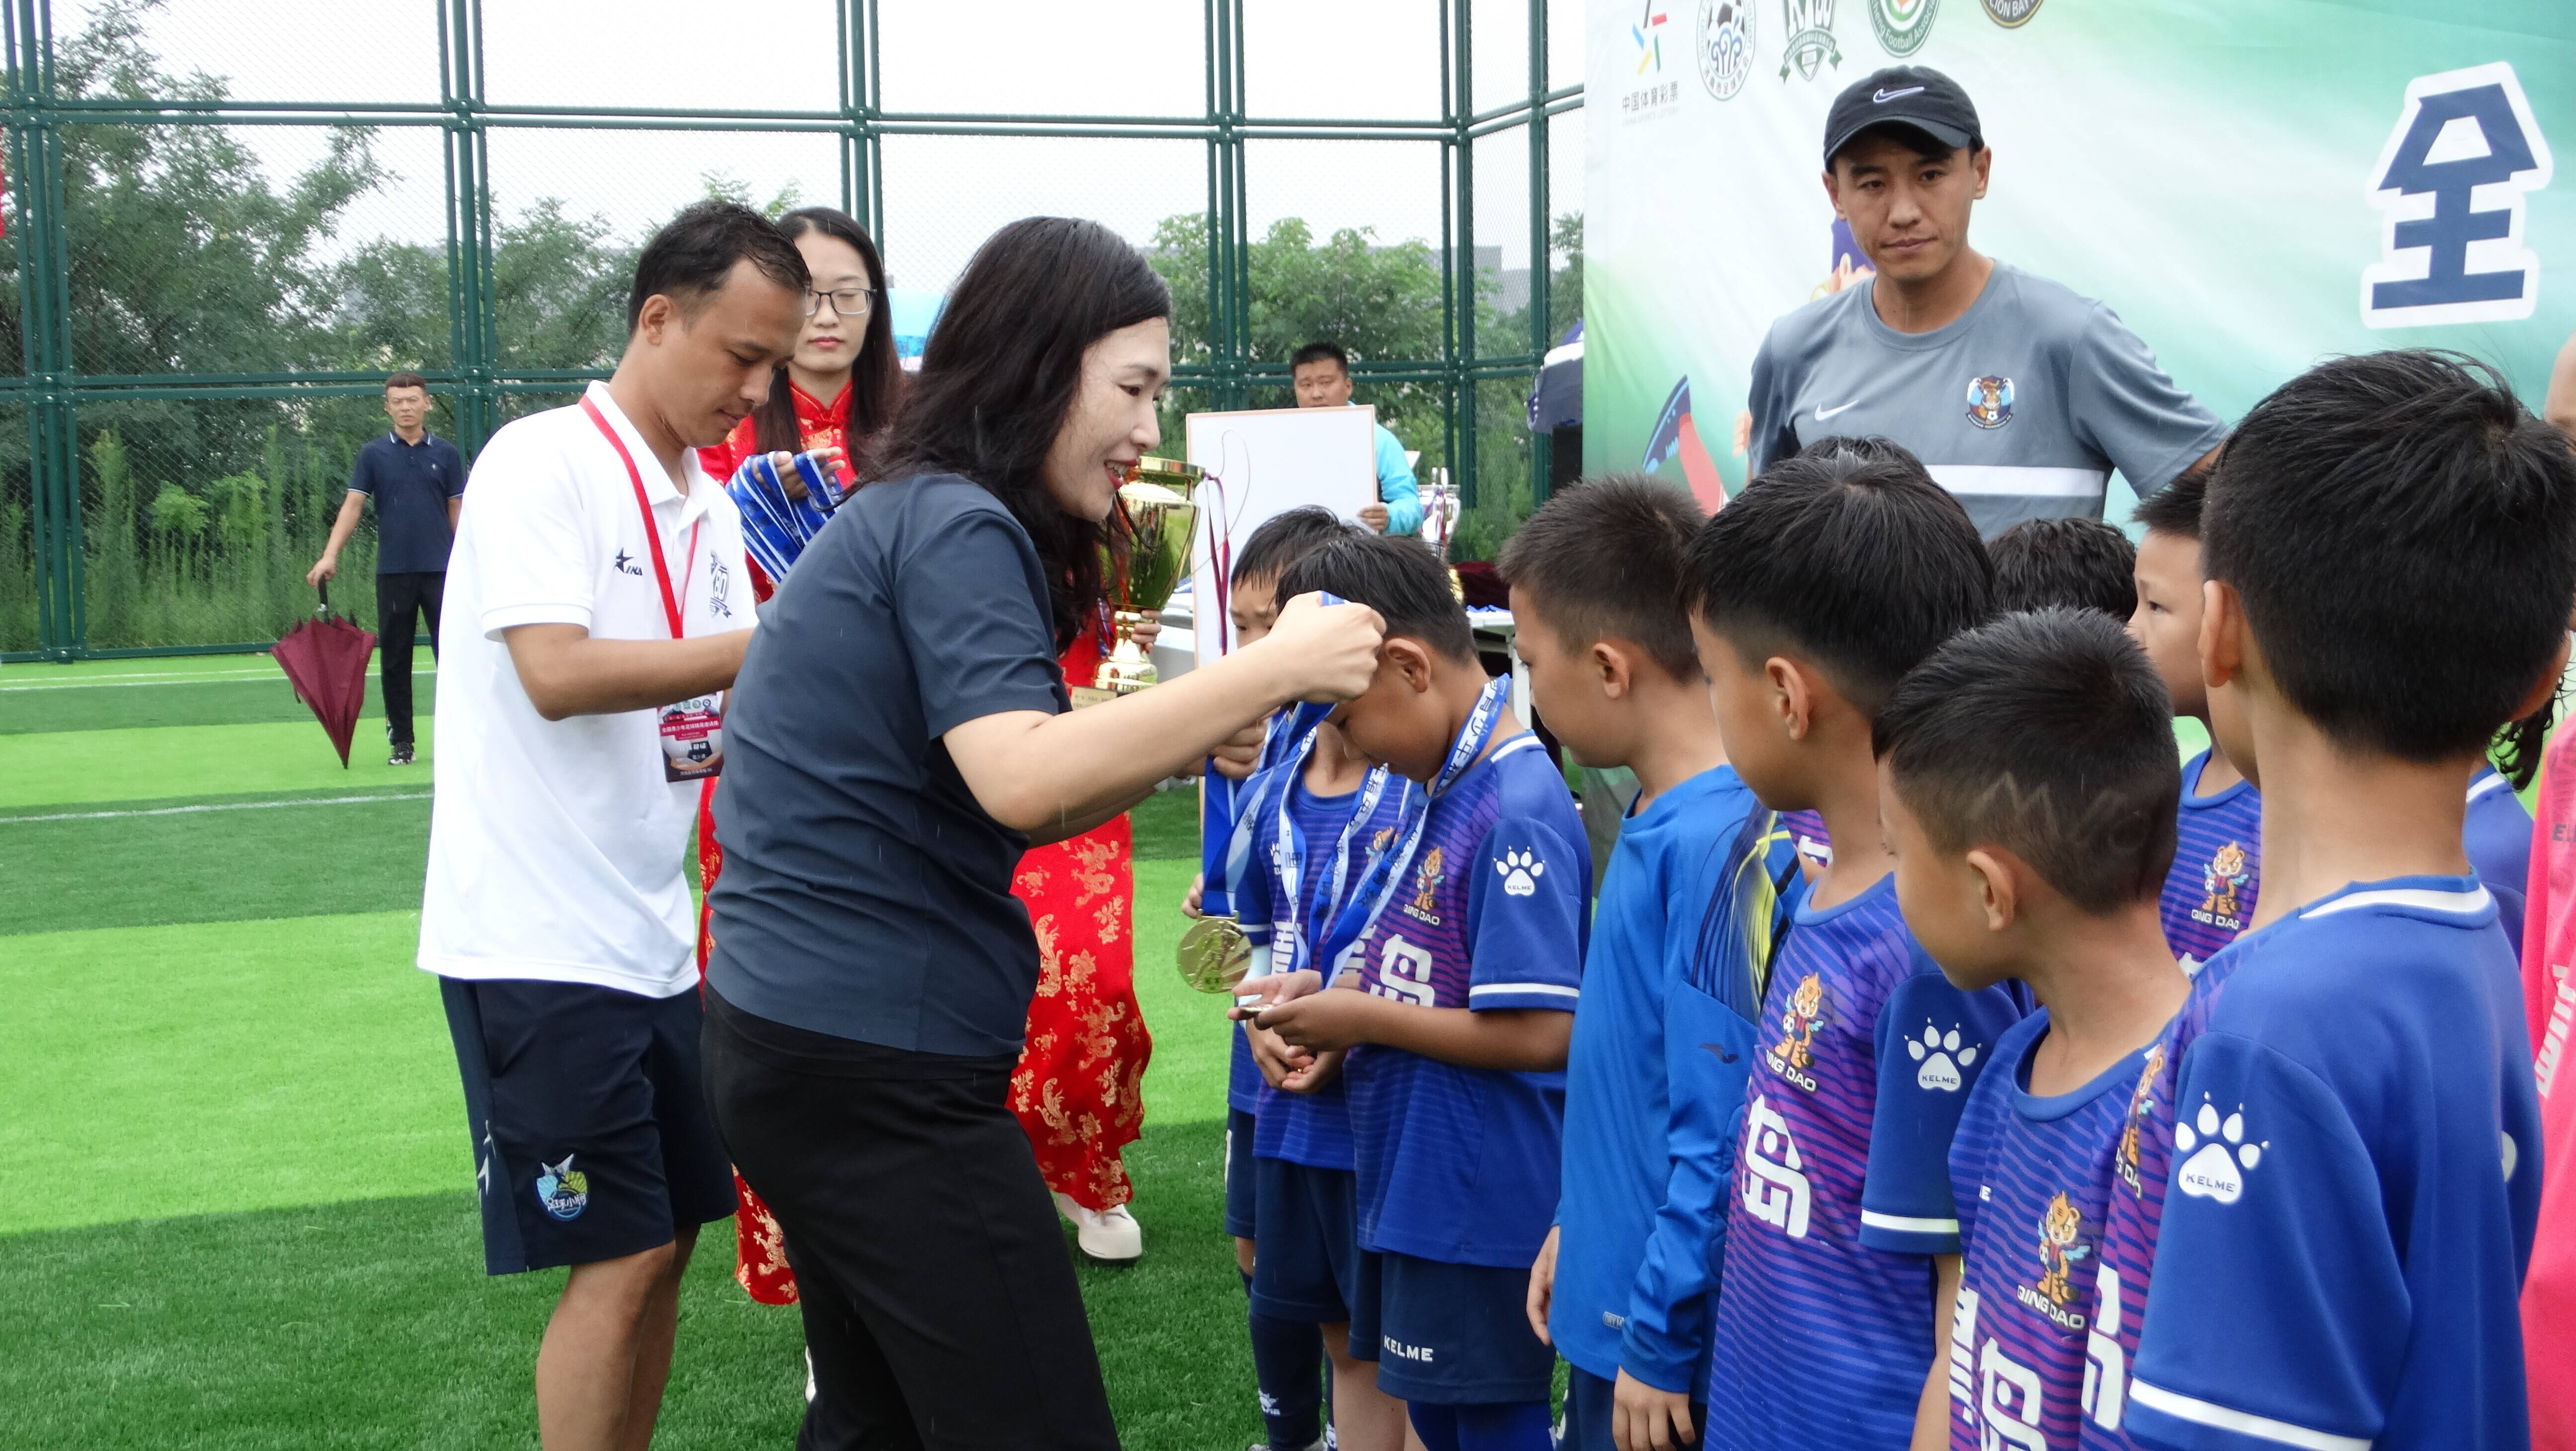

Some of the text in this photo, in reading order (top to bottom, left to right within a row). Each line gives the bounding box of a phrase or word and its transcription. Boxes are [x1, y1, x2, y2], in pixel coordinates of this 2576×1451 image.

[1885, 27, 1913, 49] Football
[1621, 80, 1678, 114] 中国体育彩票
[2371, 82, 2538, 310] 全
[1419, 911, 1440, 926] DAO
[2215, 915, 2240, 930] DAO
[1786, 1066, 1817, 1092] DAO
[1922, 1073, 1957, 1085] KELME
[2185, 1171, 2236, 1193] KELME
[2017, 1284, 2085, 1329] QING DAO
[1384, 1334, 1434, 1362] KELME
